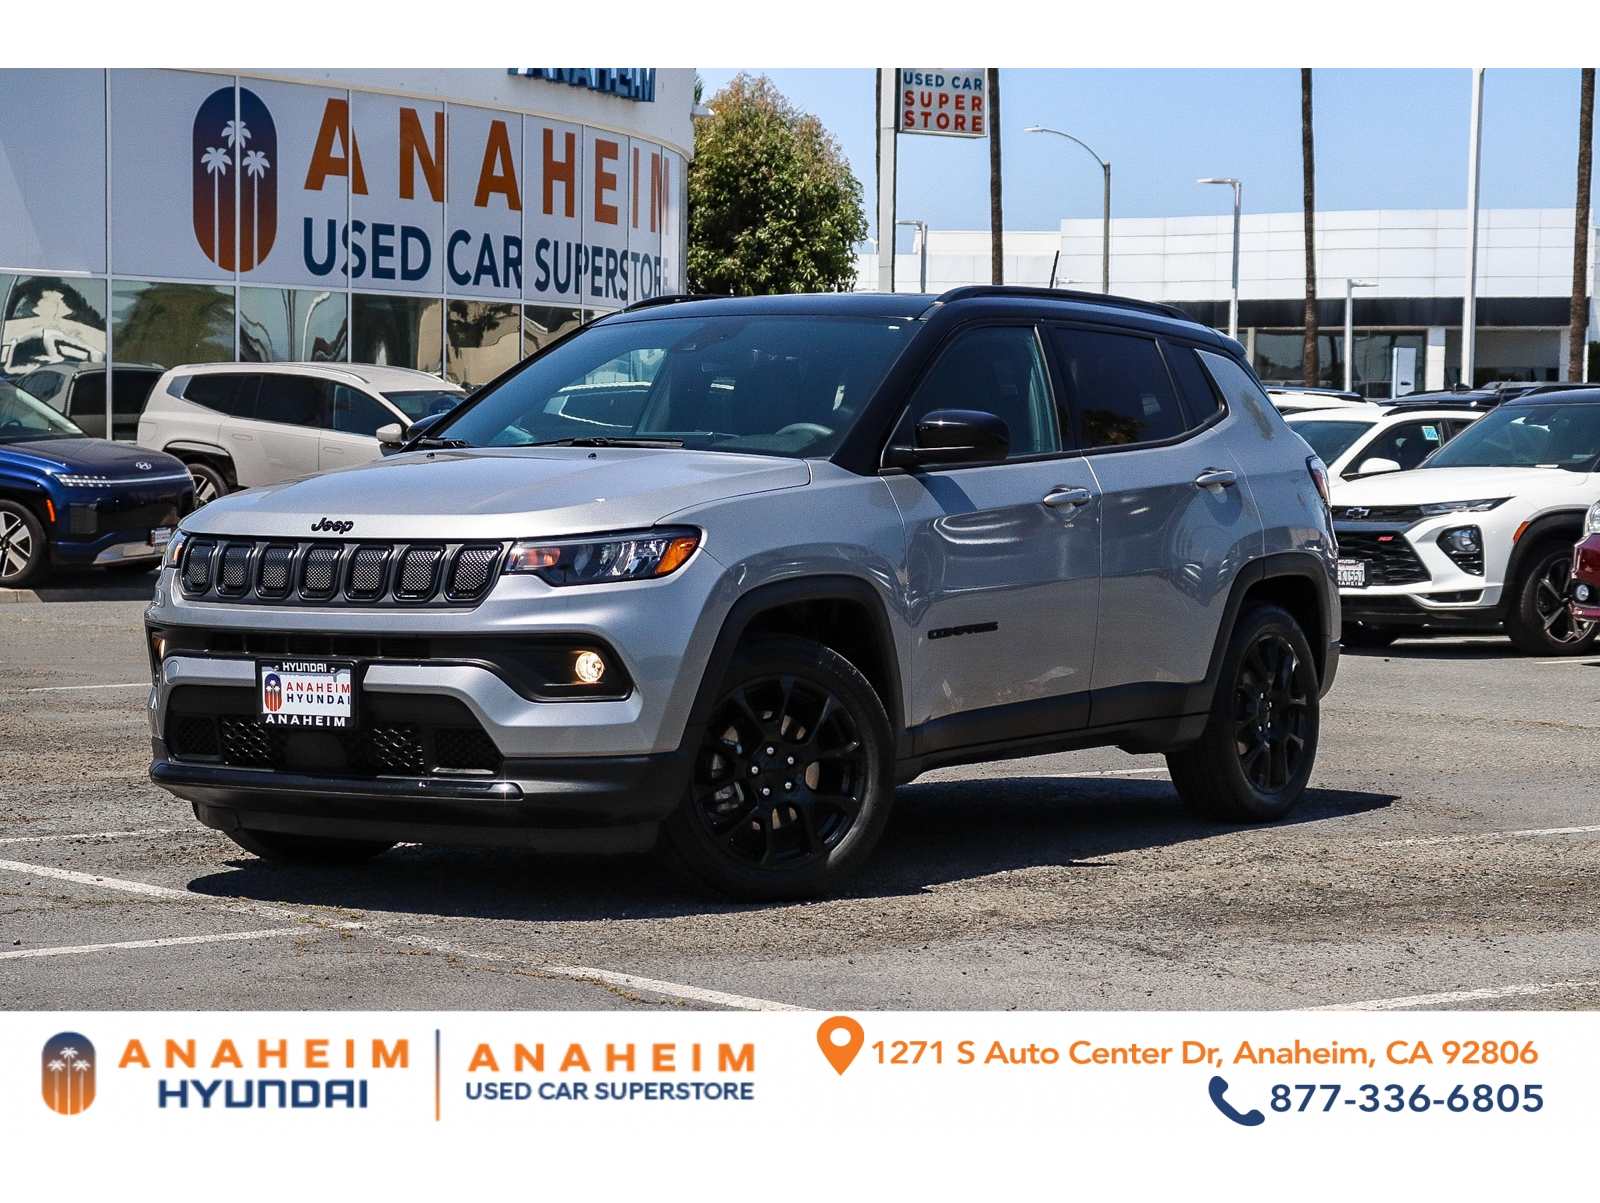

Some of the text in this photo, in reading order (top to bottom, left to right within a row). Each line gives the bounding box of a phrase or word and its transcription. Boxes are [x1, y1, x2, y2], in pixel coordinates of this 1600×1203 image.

[904, 71, 983, 91] USED CAR
[904, 90, 983, 112] SUPER
[904, 110, 983, 132] STORE
[304, 97, 670, 235] ANAHEIM
[303, 216, 432, 282] USED
[447, 229, 523, 290] CAR
[311, 517, 354, 535] Jeep
[282, 661, 327, 673] HYUNDAI
[286, 681, 351, 694] ANAHEIM
[286, 693, 351, 705] HYUNDAI
[265, 714, 346, 728] ANAHEIM
